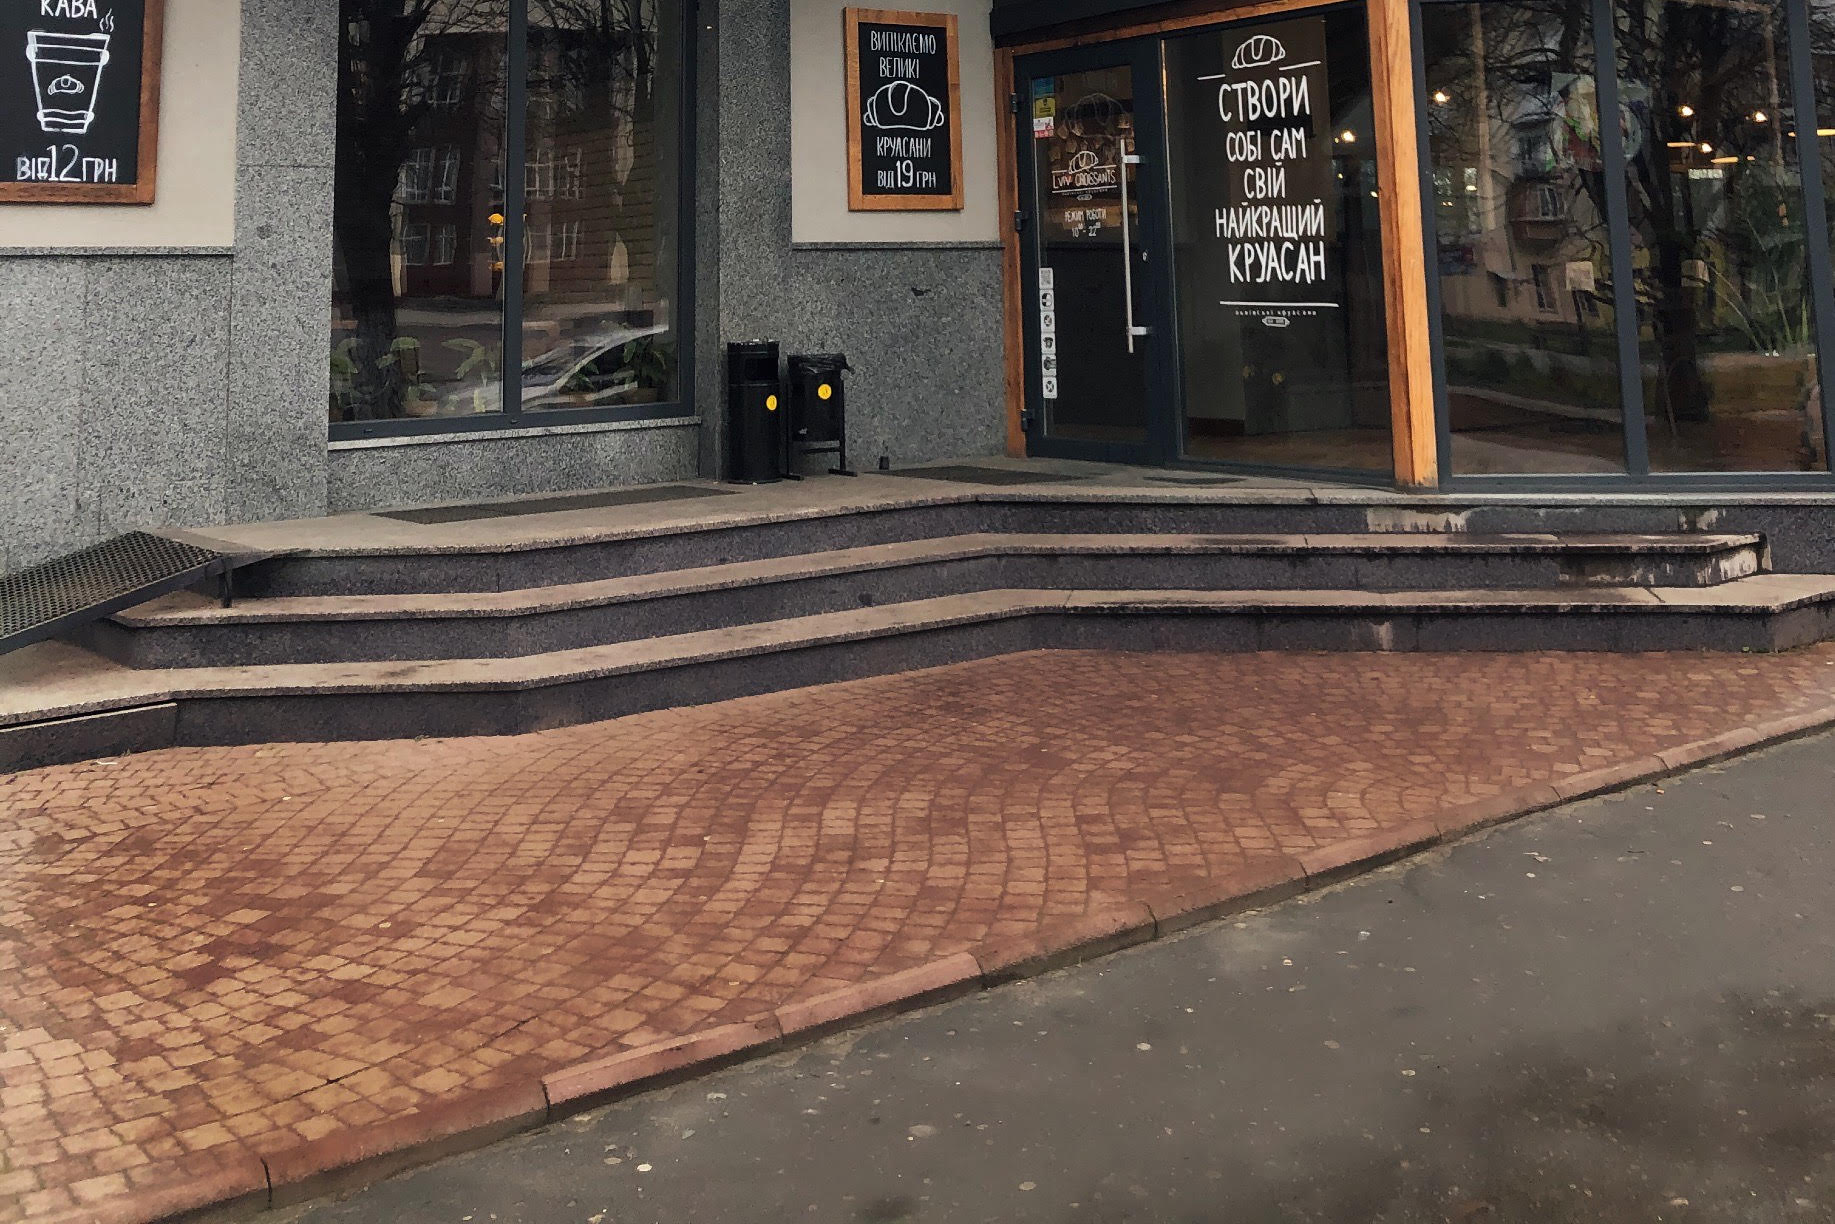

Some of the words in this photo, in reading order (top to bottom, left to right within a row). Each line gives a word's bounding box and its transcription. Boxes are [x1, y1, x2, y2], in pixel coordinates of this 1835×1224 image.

[870, 30, 937, 55] ВИПІКАЄМО
[879, 56, 919, 79] ВЕЛИКІ
[1218, 75, 1311, 122] СТВОРИ
[1226, 130, 1262, 162] СОБІ
[1270, 126, 1307, 160] САМ
[877, 170, 895, 189] ВІД
[896, 159, 914, 188] 19
[916, 170, 937, 188] ГРН
[1244, 161, 1286, 199] СВІЙ
[1215, 198, 1325, 240] НАЙКРАЩИЙ
[1228, 241, 1326, 284] КРУАСАН
